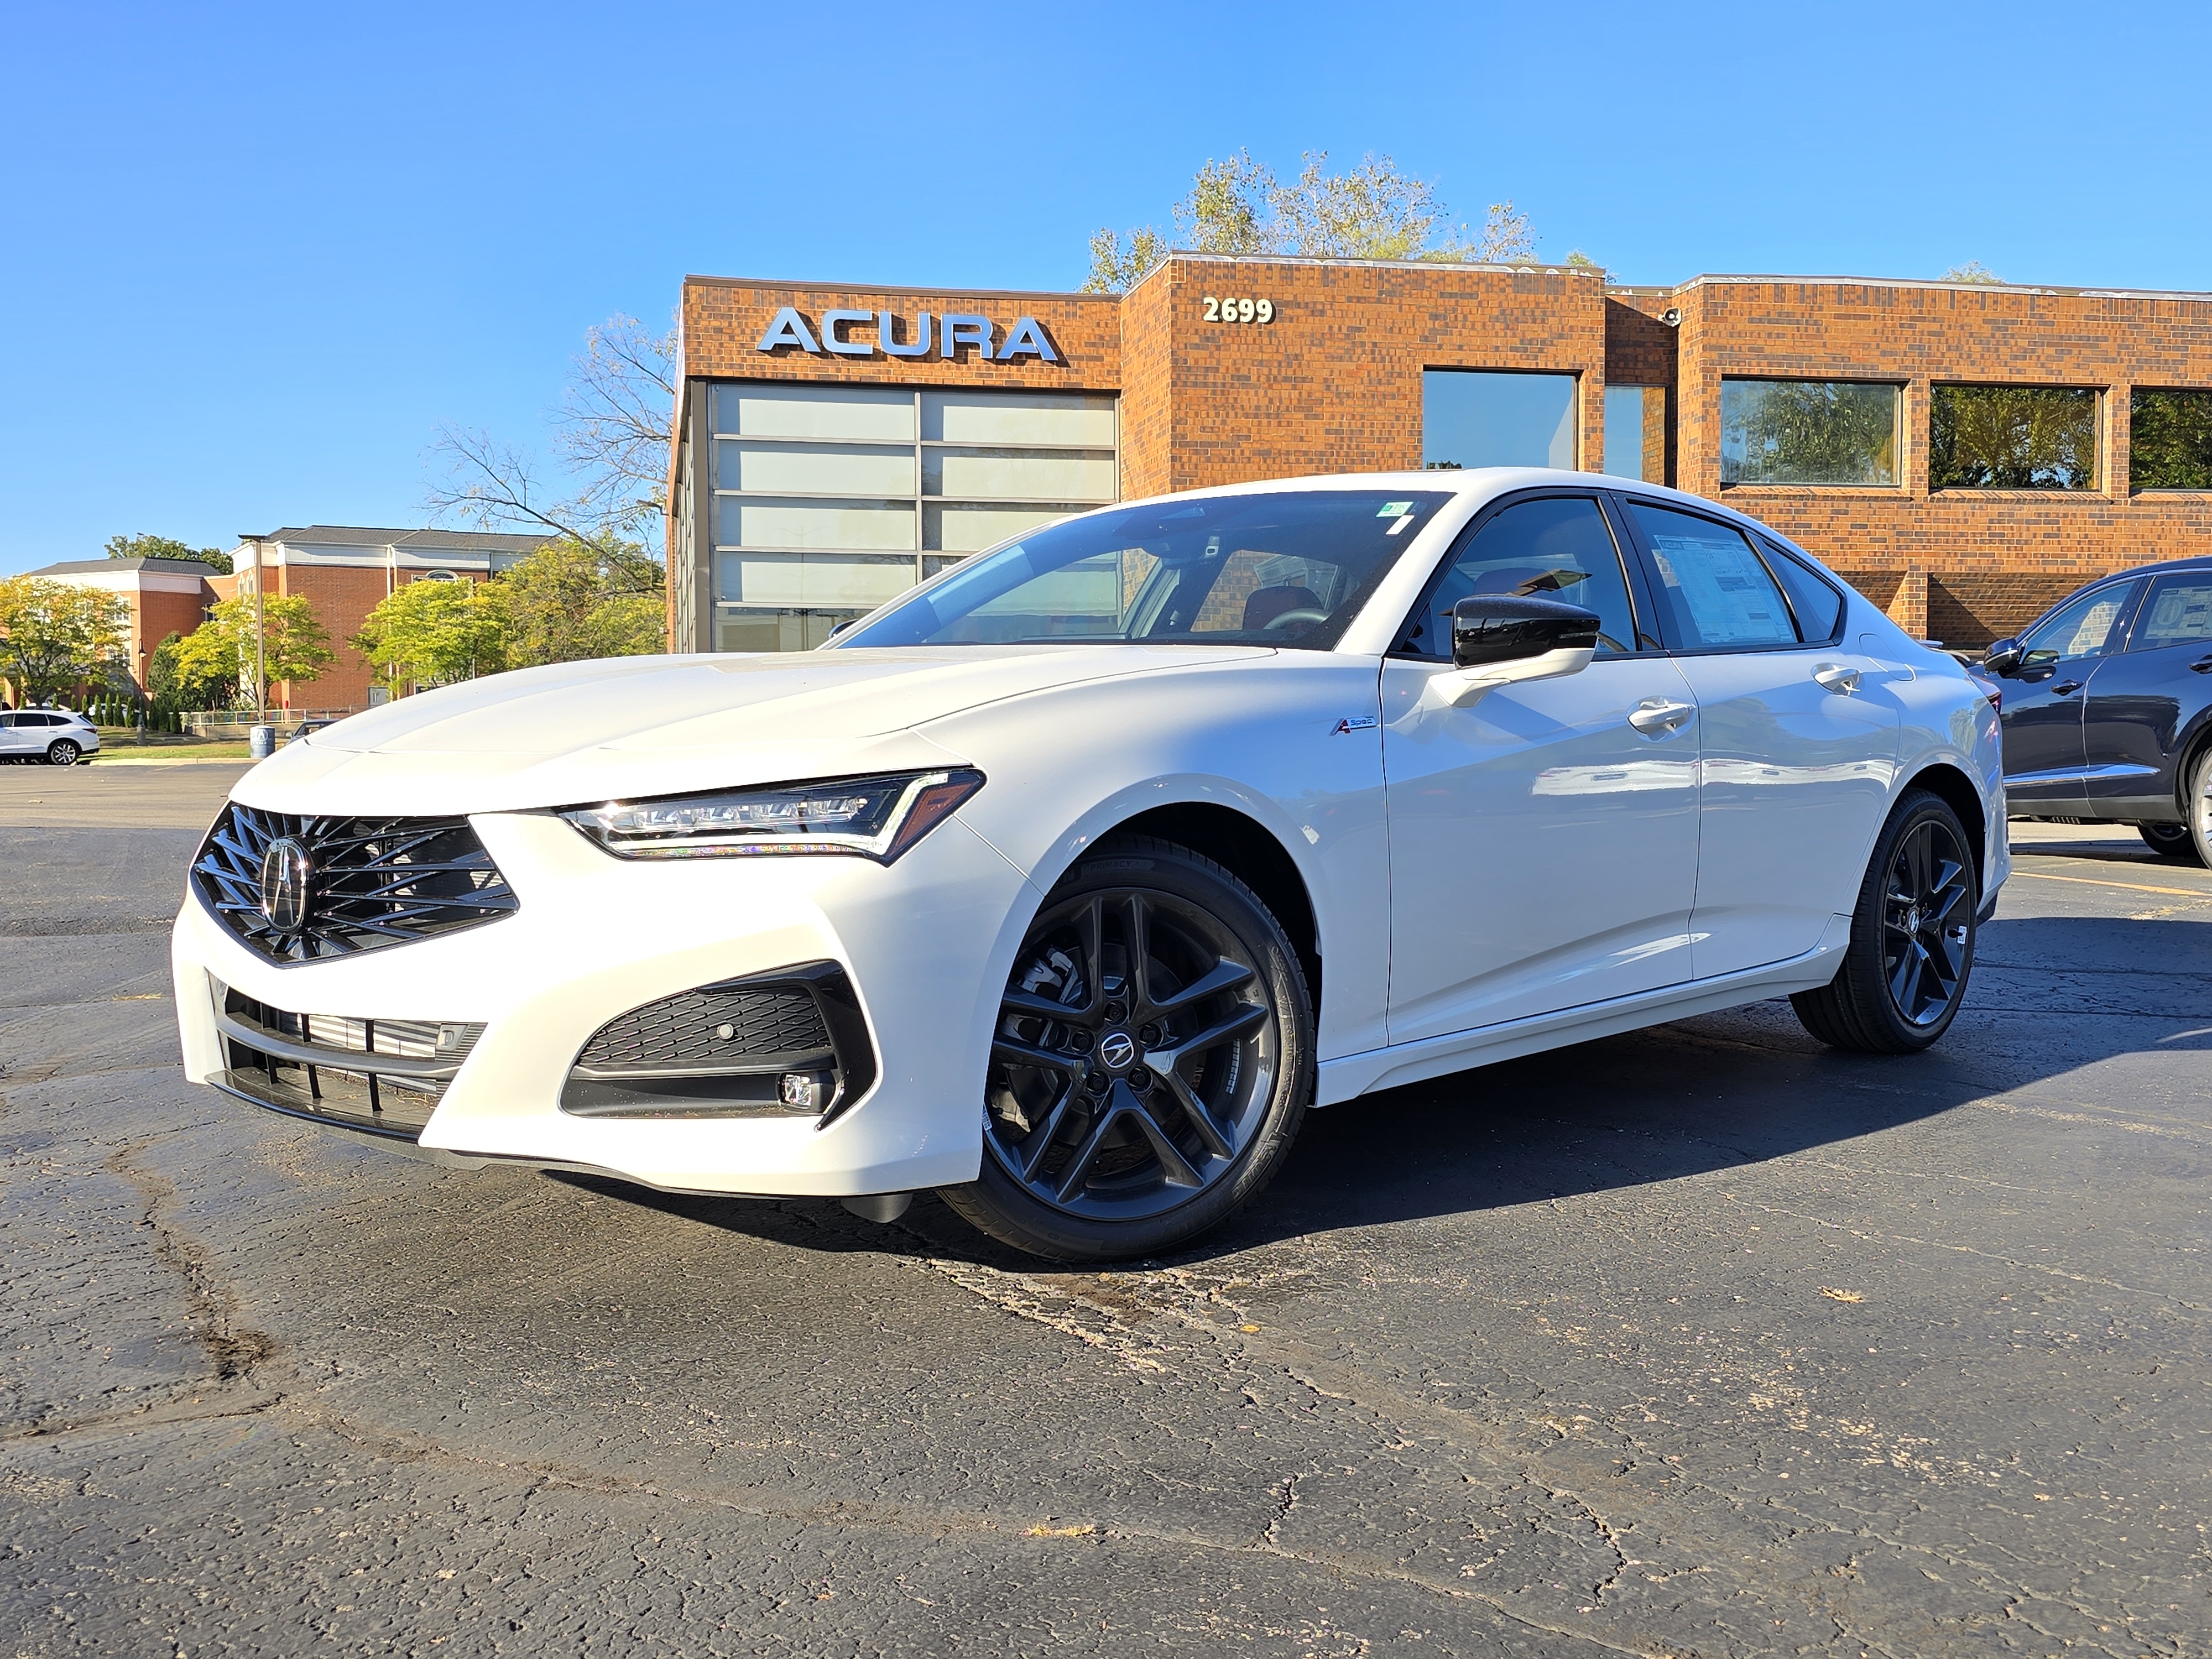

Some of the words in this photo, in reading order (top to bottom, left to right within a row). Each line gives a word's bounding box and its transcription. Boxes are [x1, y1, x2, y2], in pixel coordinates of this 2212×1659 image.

[1203, 297, 1273, 323] 2699
[757, 306, 1058, 361] ACURA
[1091, 860, 1132, 871] PRIMACY
